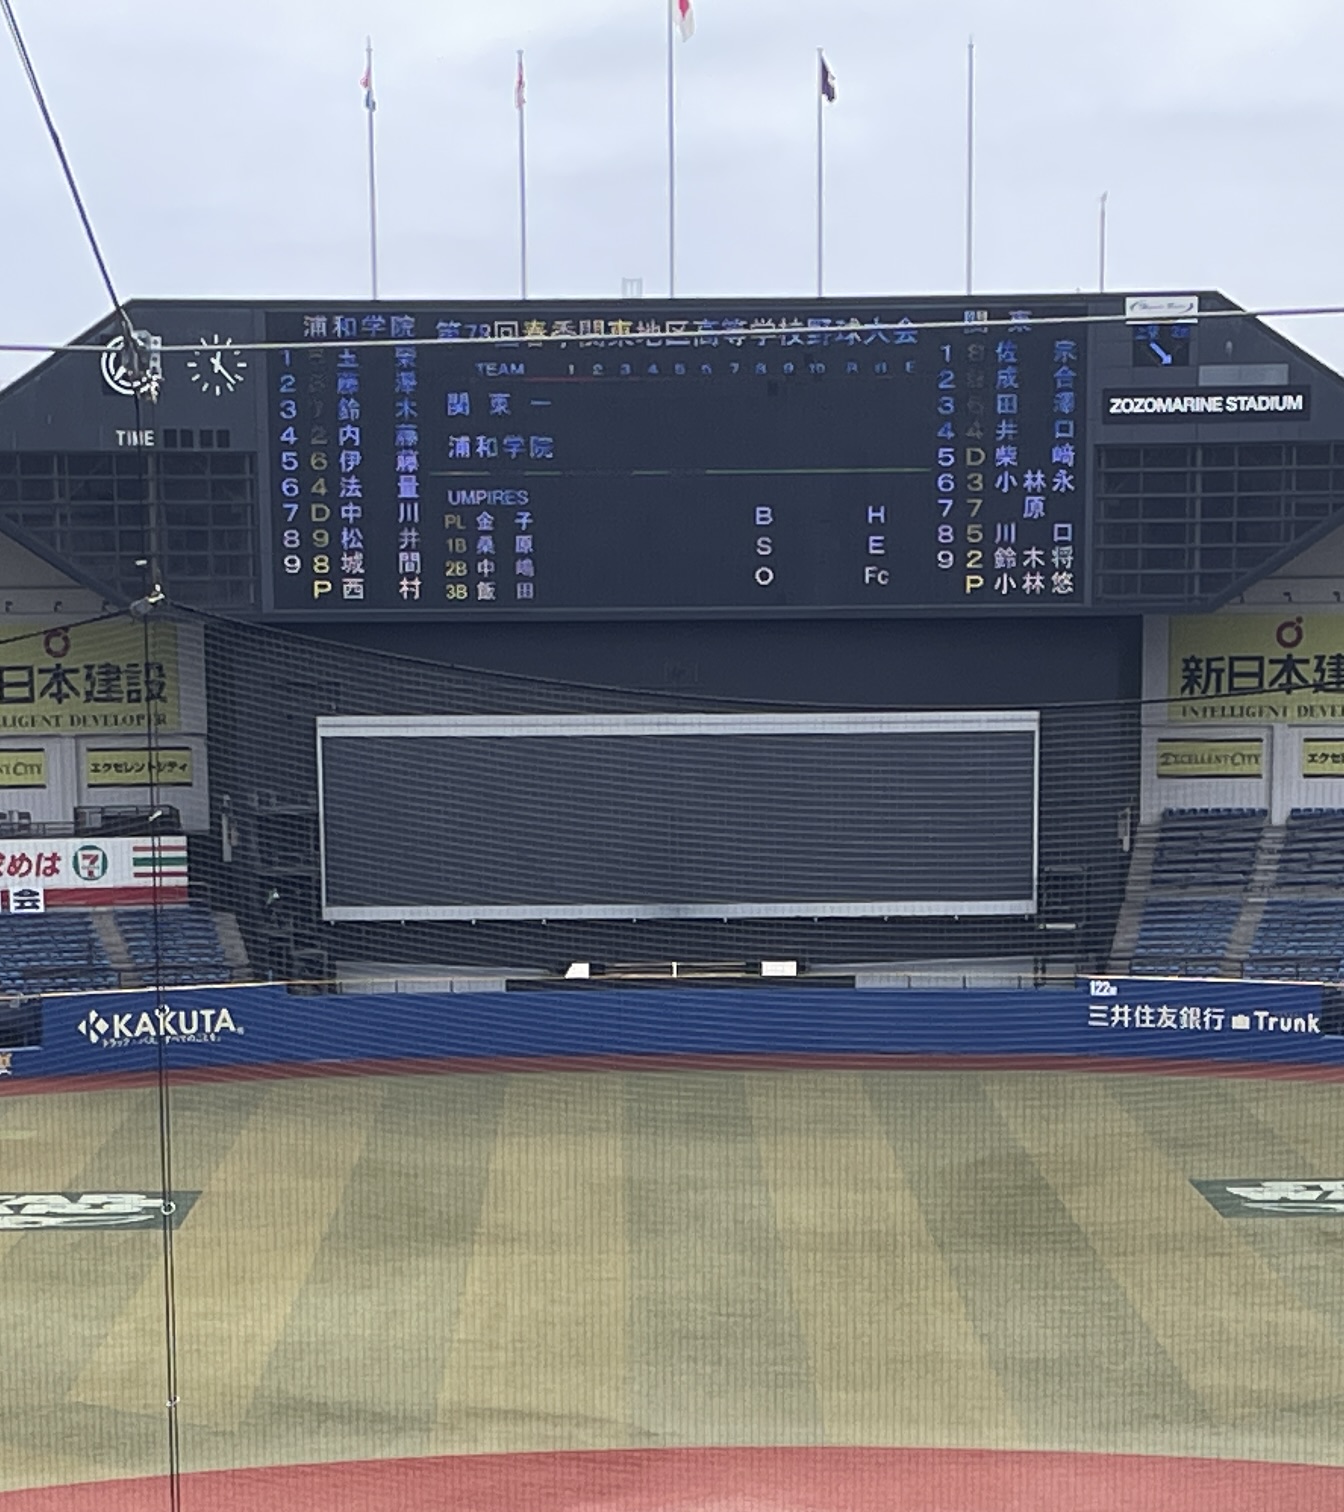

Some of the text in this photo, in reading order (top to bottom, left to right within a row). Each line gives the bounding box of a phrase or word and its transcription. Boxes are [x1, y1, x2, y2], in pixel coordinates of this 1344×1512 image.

[303, 314, 416, 338] 浦和学院
[281, 349, 291, 367] 1
[939, 344, 951, 362] 1
[474, 362, 525, 376] TEAM
[567, 363, 575, 375] 1
[592, 364, 604, 376] 2
[619, 363, 631, 375] 3
[647, 363, 659, 375] 4
[729, 362, 740, 375] 7
[279, 374, 296, 393] 2
[937, 369, 956, 389] 2
[279, 397, 418, 421] 3 鈴木
[937, 396, 955, 415] 3
[1109, 395, 1303, 415] ZOZOMARINE STADIUM
[116, 430, 155, 447] TIME
[279, 426, 298, 444] 4
[936, 420, 955, 440] 4
[996, 418, 1074, 441] 井口
[448, 434, 554, 459] 浦和学院
[281, 451, 298, 471] 5
[310, 451, 328, 470] 6
[937, 447, 986, 466] 5 D
[281, 478, 299, 497] 6
[310, 477, 328, 496] 4
[937, 469, 1075, 493] 6 3 小林永
[447, 490, 529, 505] UMPIRES
[282, 501, 420, 524] 7 D 中川
[755, 506, 773, 525] B
[867, 506, 885, 524] H
[937, 496, 1046, 519] 7 7 原
[444, 511, 534, 531] PL 金子
[283, 527, 421, 550] 8 9 松井
[937, 522, 1073, 544] 8 5 川口
[446, 538, 467, 554] 1B
[756, 537, 773, 555] S
[868, 535, 885, 554] E
[284, 554, 301, 573] 9
[313, 554, 330, 573] 8
[445, 561, 468, 577] 2B
[936, 550, 954, 569] 9
[966, 550, 984, 569] 2
[864, 565, 890, 585] Fc
[965, 574, 985, 594] P
[314, 577, 422, 600] P 西村
[445, 584, 468, 600] 3B
[1181, 705, 1288, 719] INTELLIGENT
[112, 1007, 237, 1039] KAKUTA
[1088, 1004, 1322, 1034] 三井住友銀行 Trunk
